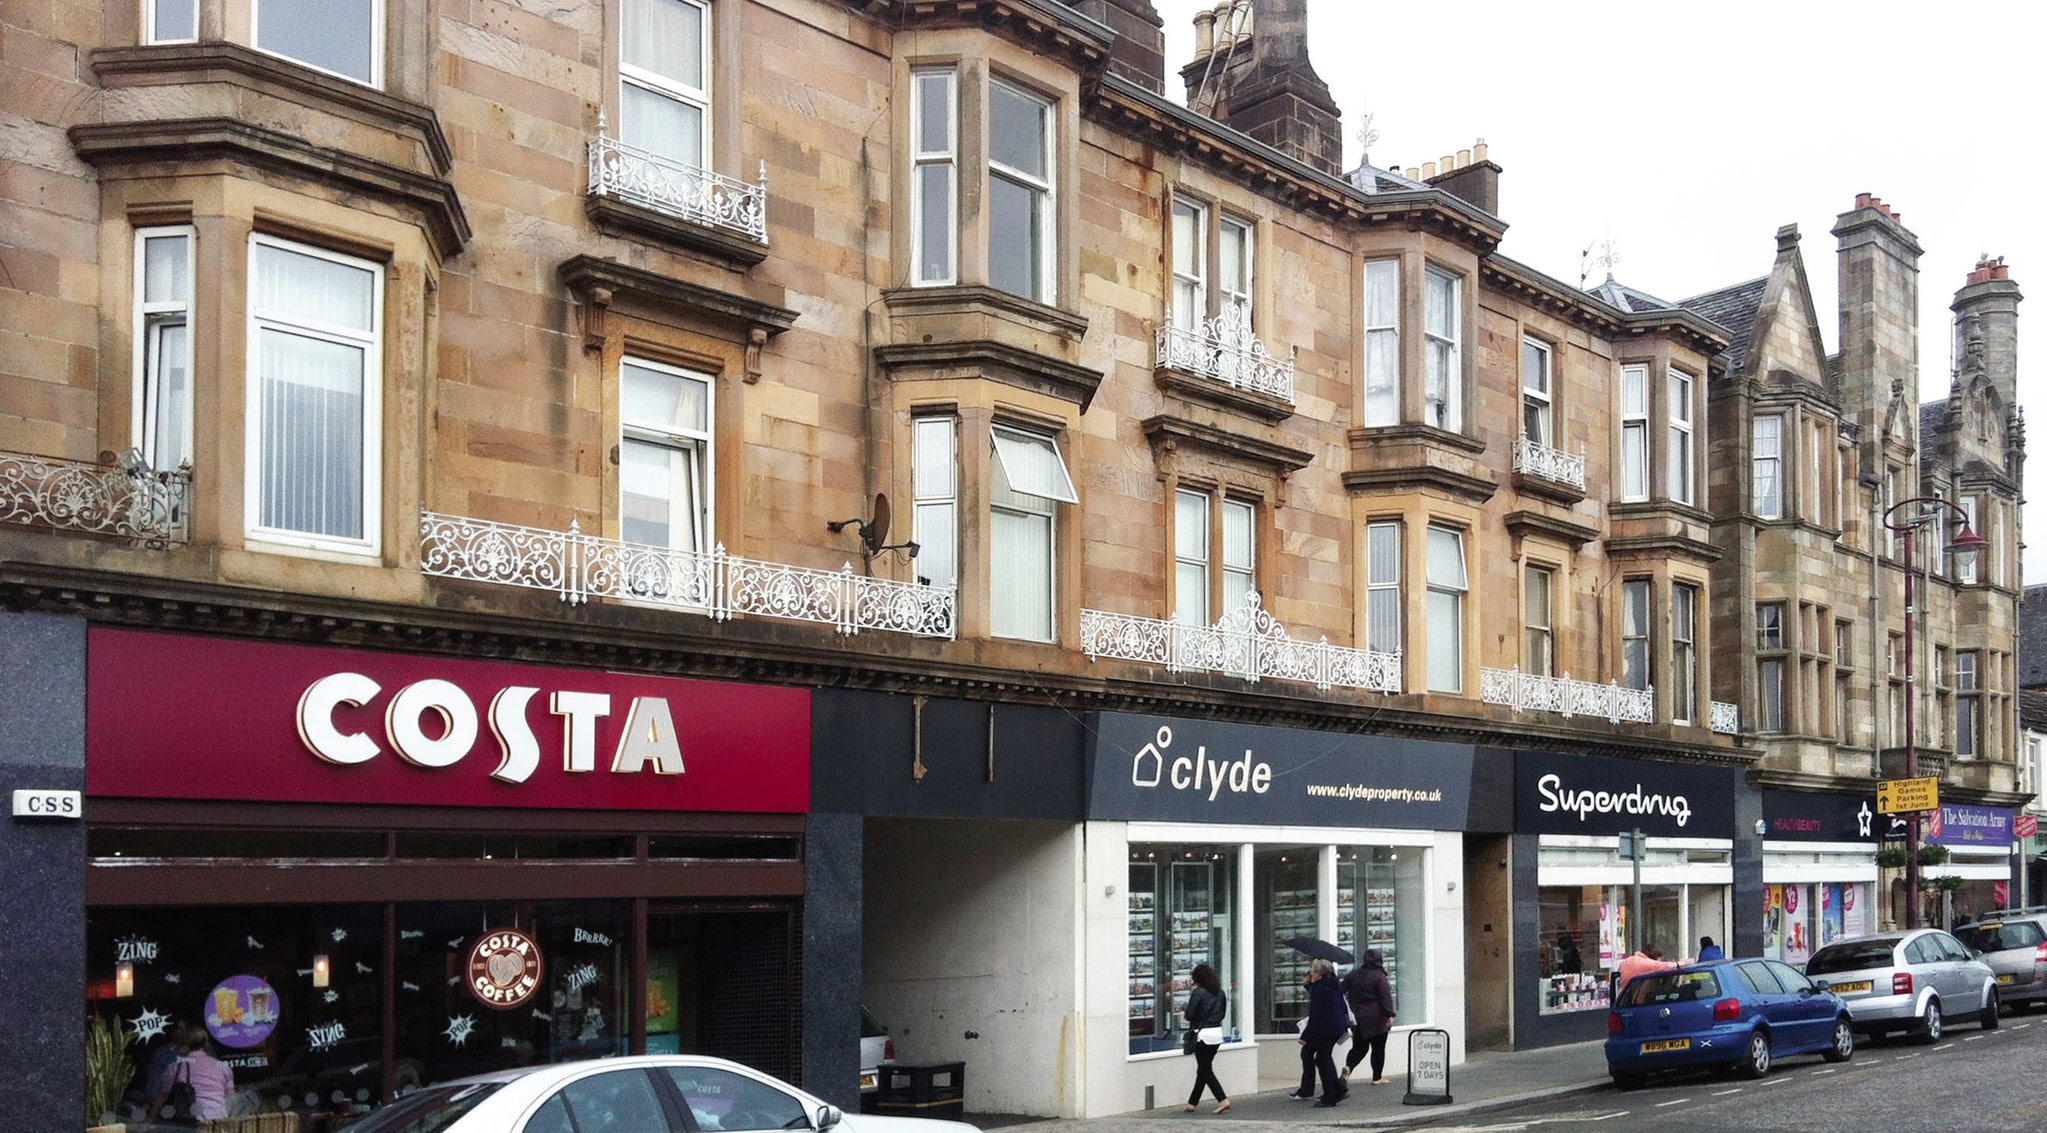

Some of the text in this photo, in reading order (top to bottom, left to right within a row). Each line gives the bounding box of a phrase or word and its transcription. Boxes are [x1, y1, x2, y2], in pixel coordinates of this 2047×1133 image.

[296, 672, 686, 784] COSTA
[1170, 746, 1272, 801] clyde
[1893, 779, 1931, 788] Highland
[1306, 783, 1442, 803] www.clydeproperty.co.uk
[1537, 773, 1692, 827] Superdrug
[1943, 808, 1957, 825] The
[1958, 809, 1988, 827] Salvation
[1989, 812, 2007, 831] Army
[118, 941, 158, 961] ZING
[479, 934, 529, 957] COSTA
[475, 974, 535, 1002] COFFEE
[567, 964, 598, 992] ZING
[138, 1018, 163, 1032] POP
[450, 1019, 469, 1037] POP
[1417, 1071, 1445, 1079] 7 DAYS
[1419, 1061, 1441, 1070] OPEN
